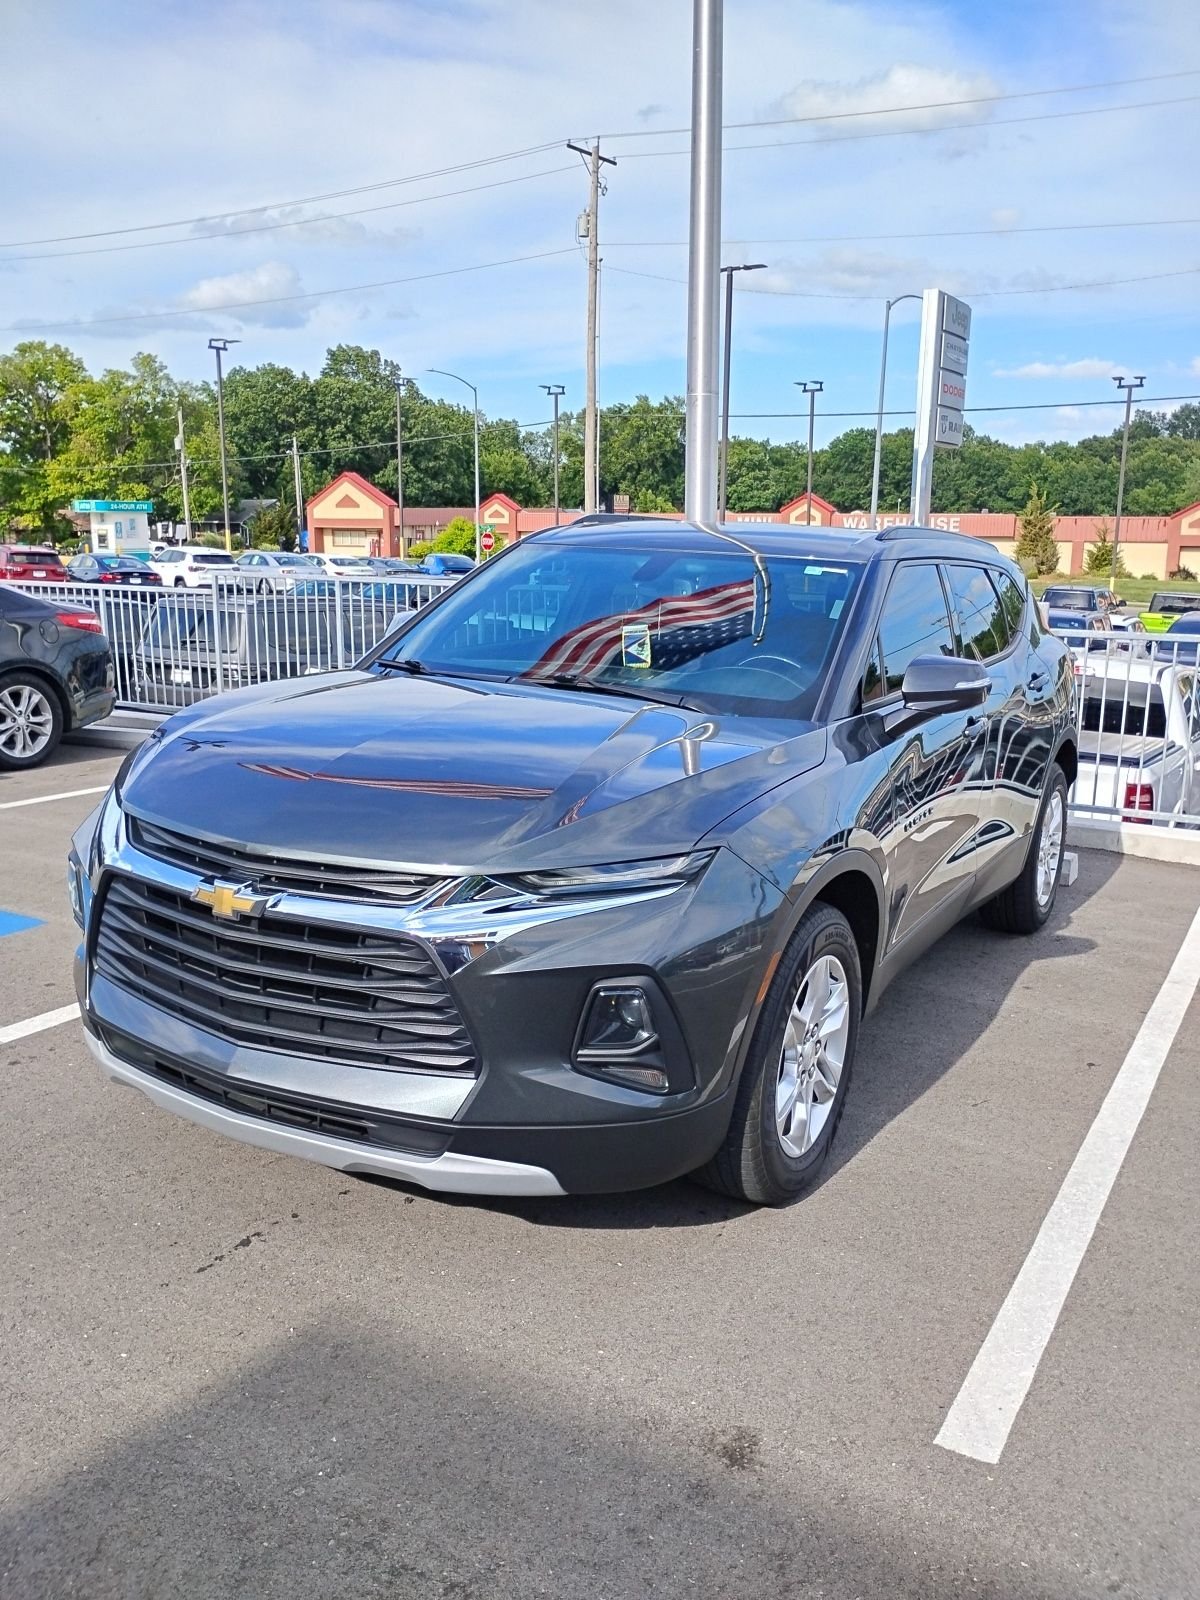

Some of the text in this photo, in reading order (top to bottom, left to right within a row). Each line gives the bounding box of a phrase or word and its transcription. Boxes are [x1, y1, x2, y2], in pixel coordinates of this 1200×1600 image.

[951, 303, 968, 336] Jeep
[943, 384, 965, 399] DODGE
[843, 516, 961, 532] WAREHSE
